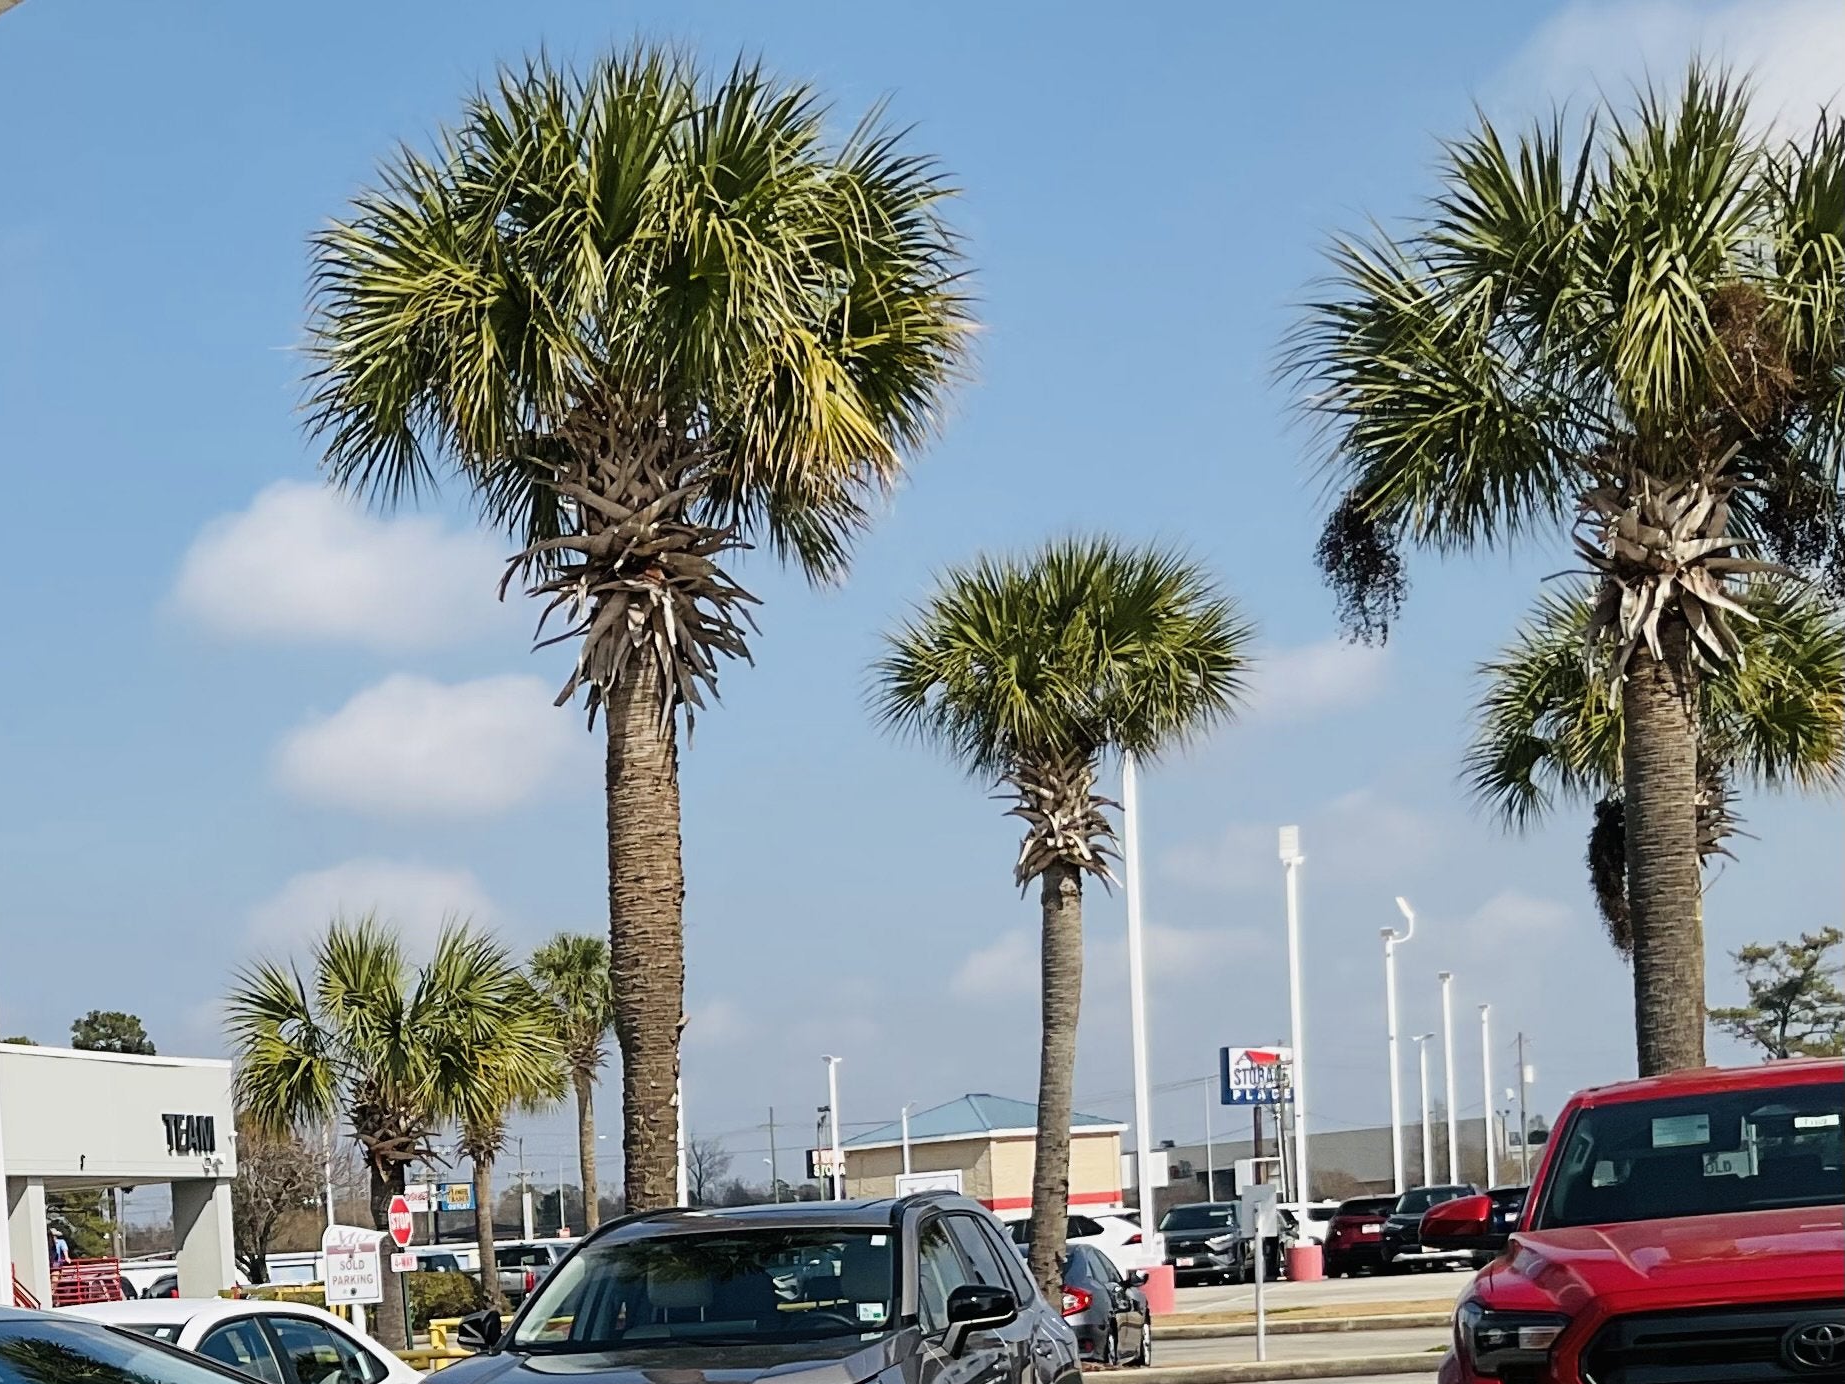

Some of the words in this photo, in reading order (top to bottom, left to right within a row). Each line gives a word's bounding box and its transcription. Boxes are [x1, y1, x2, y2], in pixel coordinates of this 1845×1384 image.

[1232, 1089, 1291, 1100] PLACE
[162, 1114, 215, 1153] TEAM
[390, 1212, 411, 1230] STOP
[340, 1259, 365, 1270] SOLD
[332, 1274, 374, 1286] PARKING
